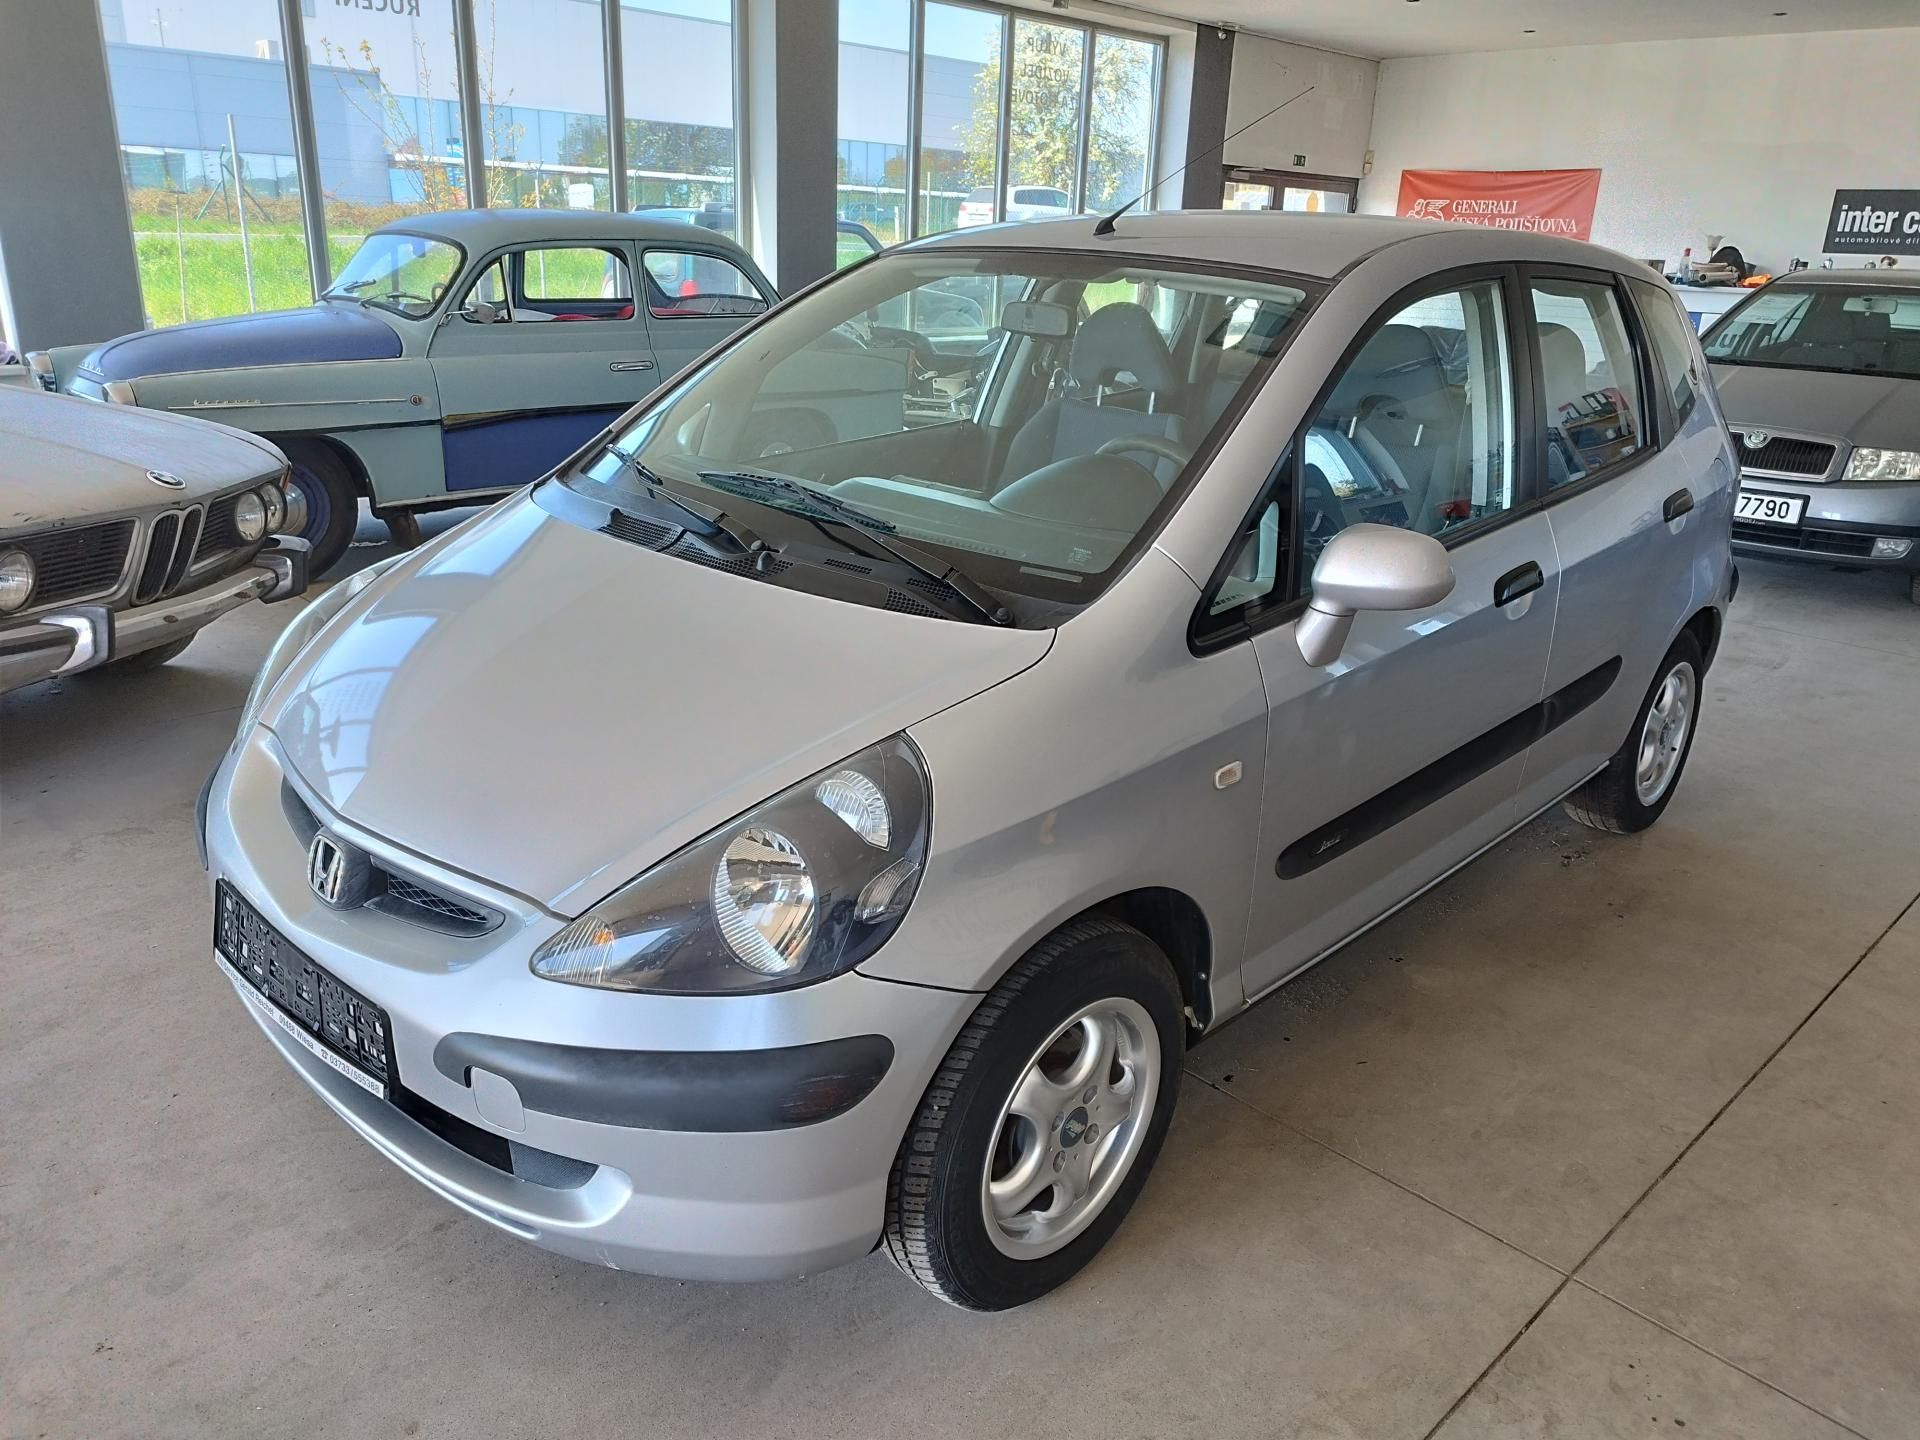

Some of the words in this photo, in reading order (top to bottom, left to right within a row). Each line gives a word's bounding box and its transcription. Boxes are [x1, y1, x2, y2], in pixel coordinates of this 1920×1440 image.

[1452, 199, 1518, 214] GENERALI
[1836, 204, 1899, 233] inter
[1902, 210, 1920, 234] c
[1834, 236, 1901, 244] automobilové
[1738, 496, 1791, 519] 7790
